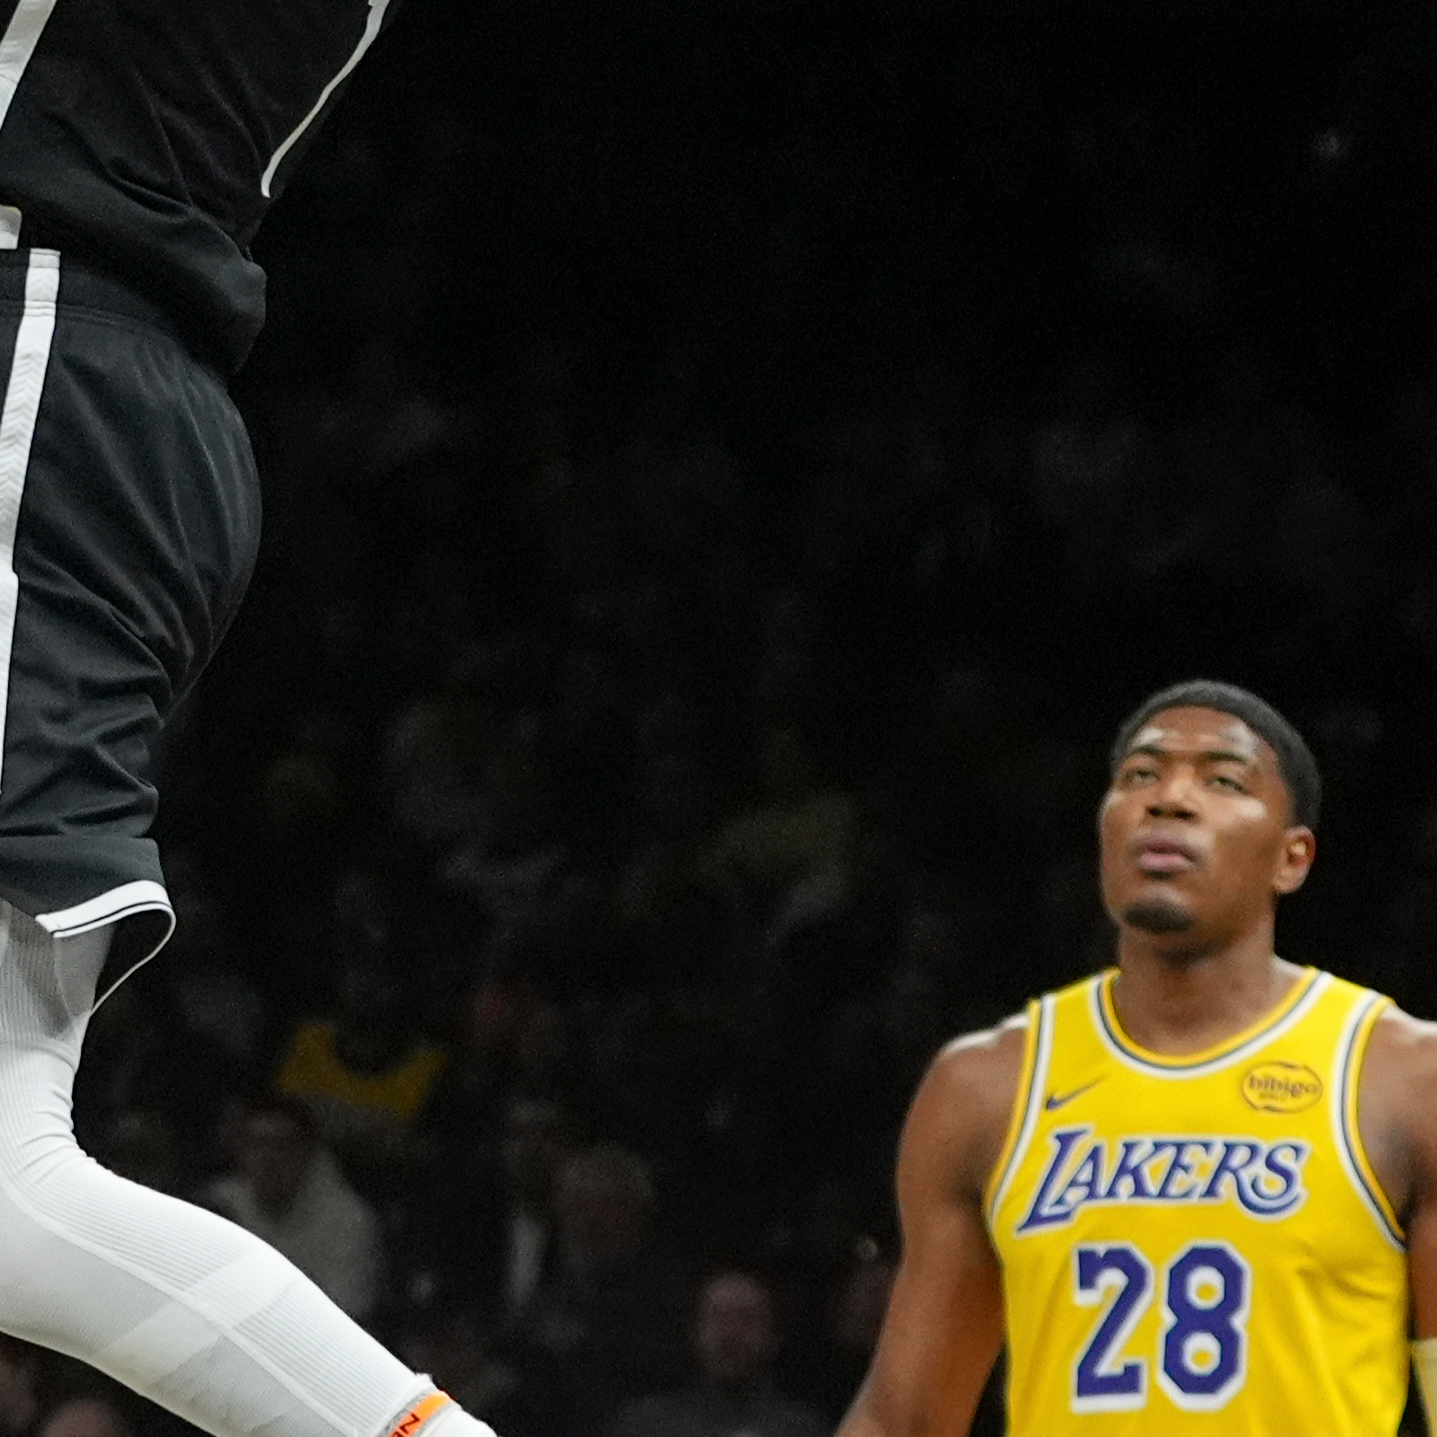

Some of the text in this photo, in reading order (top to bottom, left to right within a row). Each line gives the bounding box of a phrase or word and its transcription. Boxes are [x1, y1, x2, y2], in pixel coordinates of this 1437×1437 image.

[1249, 1075, 1319, 1098] bibigo
[1013, 1122, 1312, 1237] LAKERS
[1069, 1240, 1252, 1416] 28
